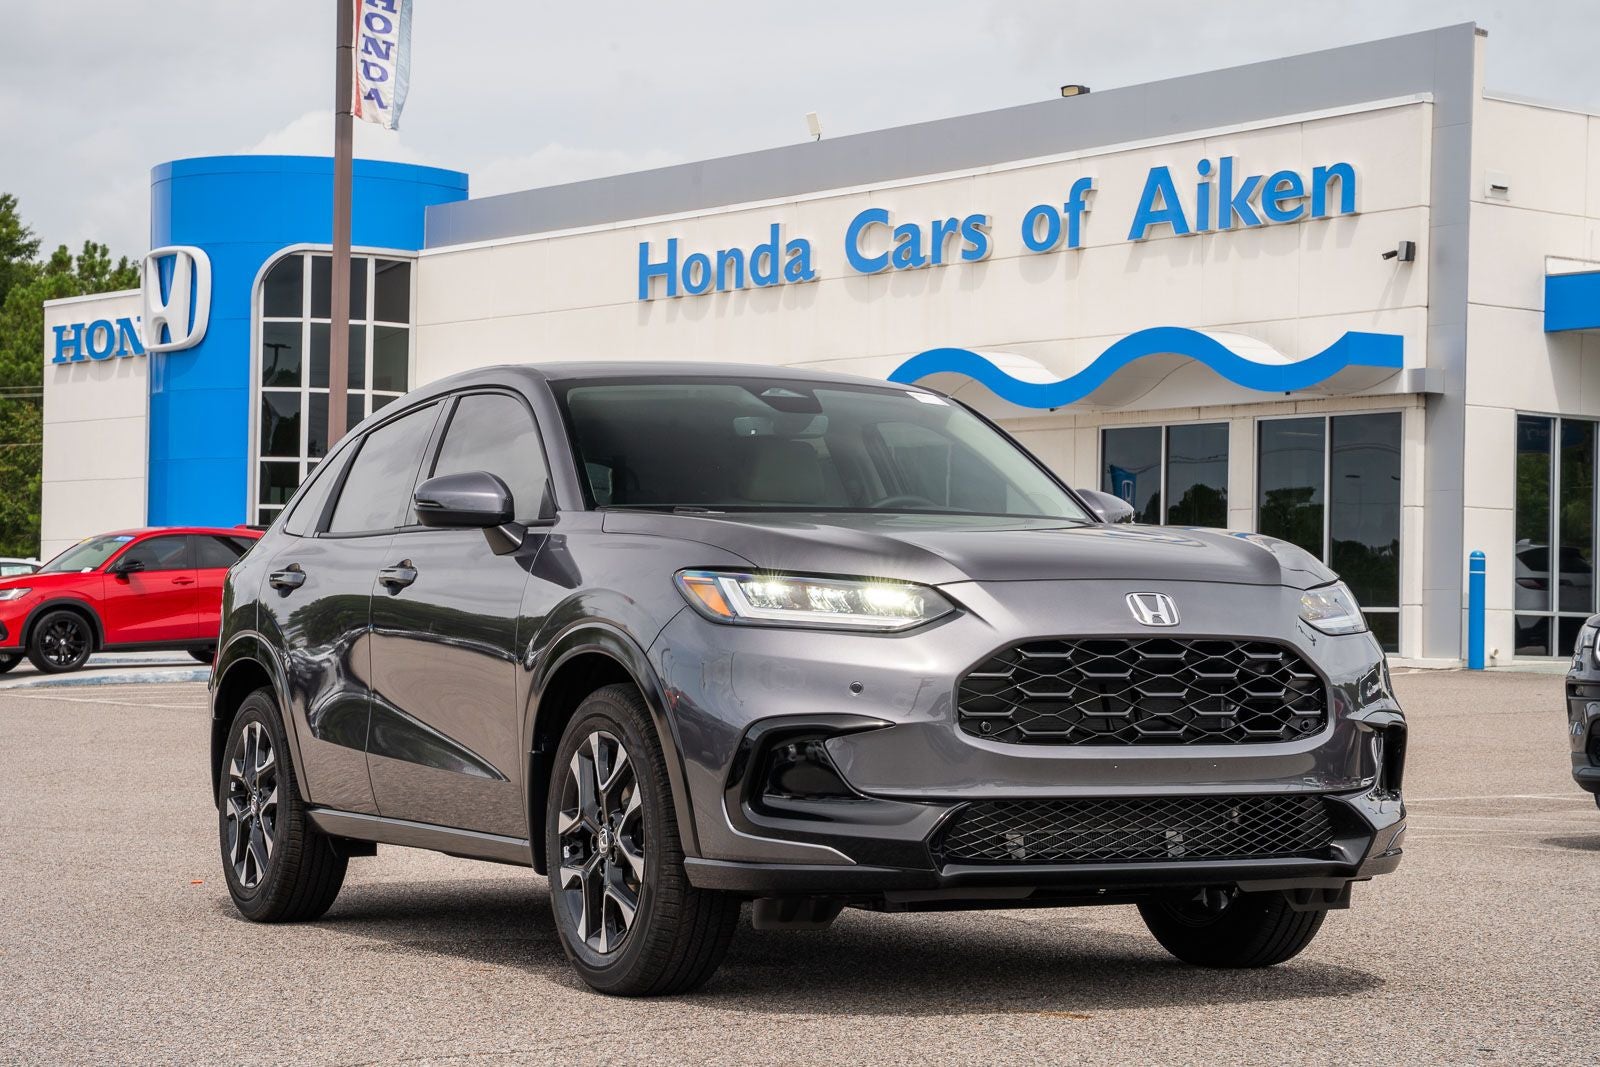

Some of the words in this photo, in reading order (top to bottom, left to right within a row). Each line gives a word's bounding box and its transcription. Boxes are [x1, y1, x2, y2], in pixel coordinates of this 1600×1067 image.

[638, 223, 815, 300] Honda
[844, 208, 988, 273] Cars
[1021, 177, 1093, 253] of
[1128, 156, 1356, 241] Aiken
